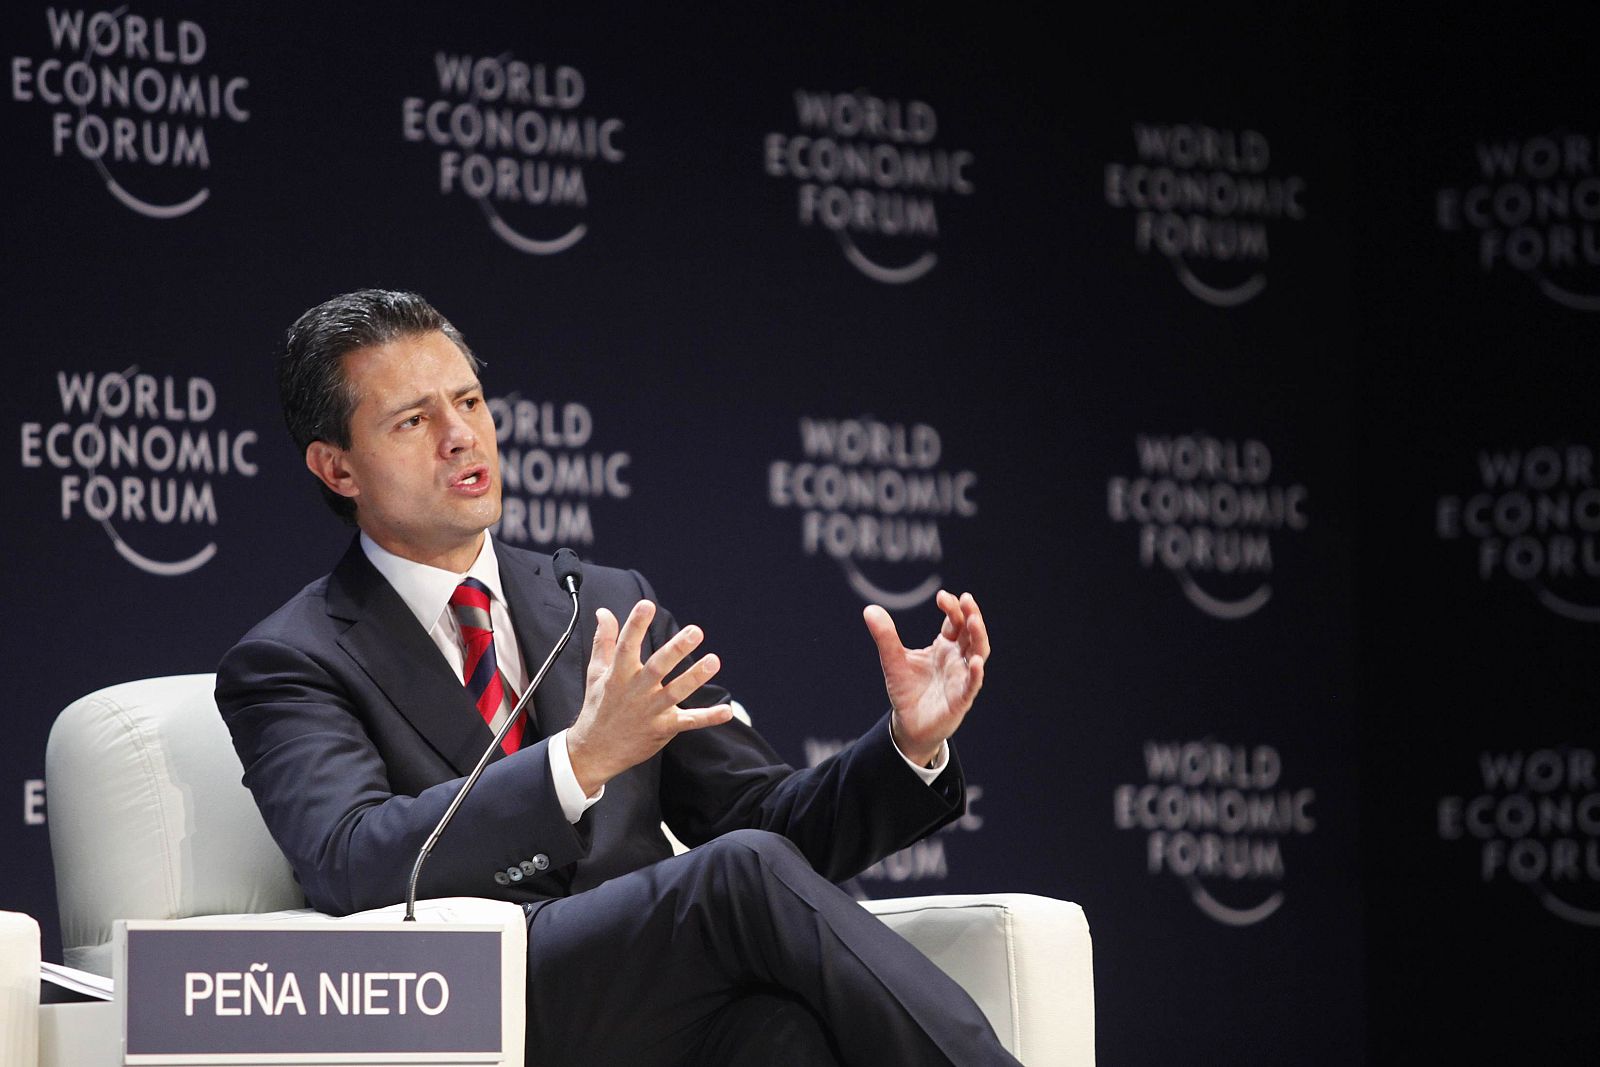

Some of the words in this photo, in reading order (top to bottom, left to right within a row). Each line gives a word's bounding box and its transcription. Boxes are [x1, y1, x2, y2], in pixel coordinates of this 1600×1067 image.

[46, 6, 207, 65] WORLD
[11, 56, 250, 122] ECONOMIC
[434, 51, 586, 109] WORLD
[53, 112, 210, 170] FORUM
[402, 96, 626, 163] ECONOMIC
[792, 87, 938, 144] WORLD
[764, 131, 976, 195] ECONOMIC
[1132, 121, 1271, 174] WORLD
[1476, 134, 1600, 178] WOR
[439, 151, 588, 208] FORUM
[1103, 162, 1307, 221] ECONOMIC
[1436, 178, 1600, 231] ECONO
[798, 183, 939, 238] FORUM
[1135, 211, 1270, 262] FORUM
[1479, 223, 1600, 272] FORU
[57, 370, 217, 422] WORLD
[486, 397, 593, 448] ORLD
[20, 422, 259, 477] ECONOMIC
[800, 416, 942, 469] WORLD
[1135, 433, 1272, 485] WORLD
[1478, 445, 1594, 491] WOR
[61, 474, 218, 526] FORUM
[499, 448, 632, 499] NOMIC
[769, 460, 978, 517] ECONOMIC
[490, 496, 595, 546] RUM
[1107, 476, 1309, 531] ECONOMIC
[1435, 488, 1600, 539] ECONO
[802, 510, 943, 563] FORUM
[1139, 523, 1273, 574] FORUM
[1144, 739, 1282, 790] WORLD
[1479, 748, 1597, 793] WOR
[1114, 784, 1316, 834] ECONOMIC
[1436, 793, 1600, 840] ECONO
[1147, 830, 1285, 881] FORUM
[185, 962, 306, 1016] PEÑA
[319, 971, 449, 1016] NIETO
